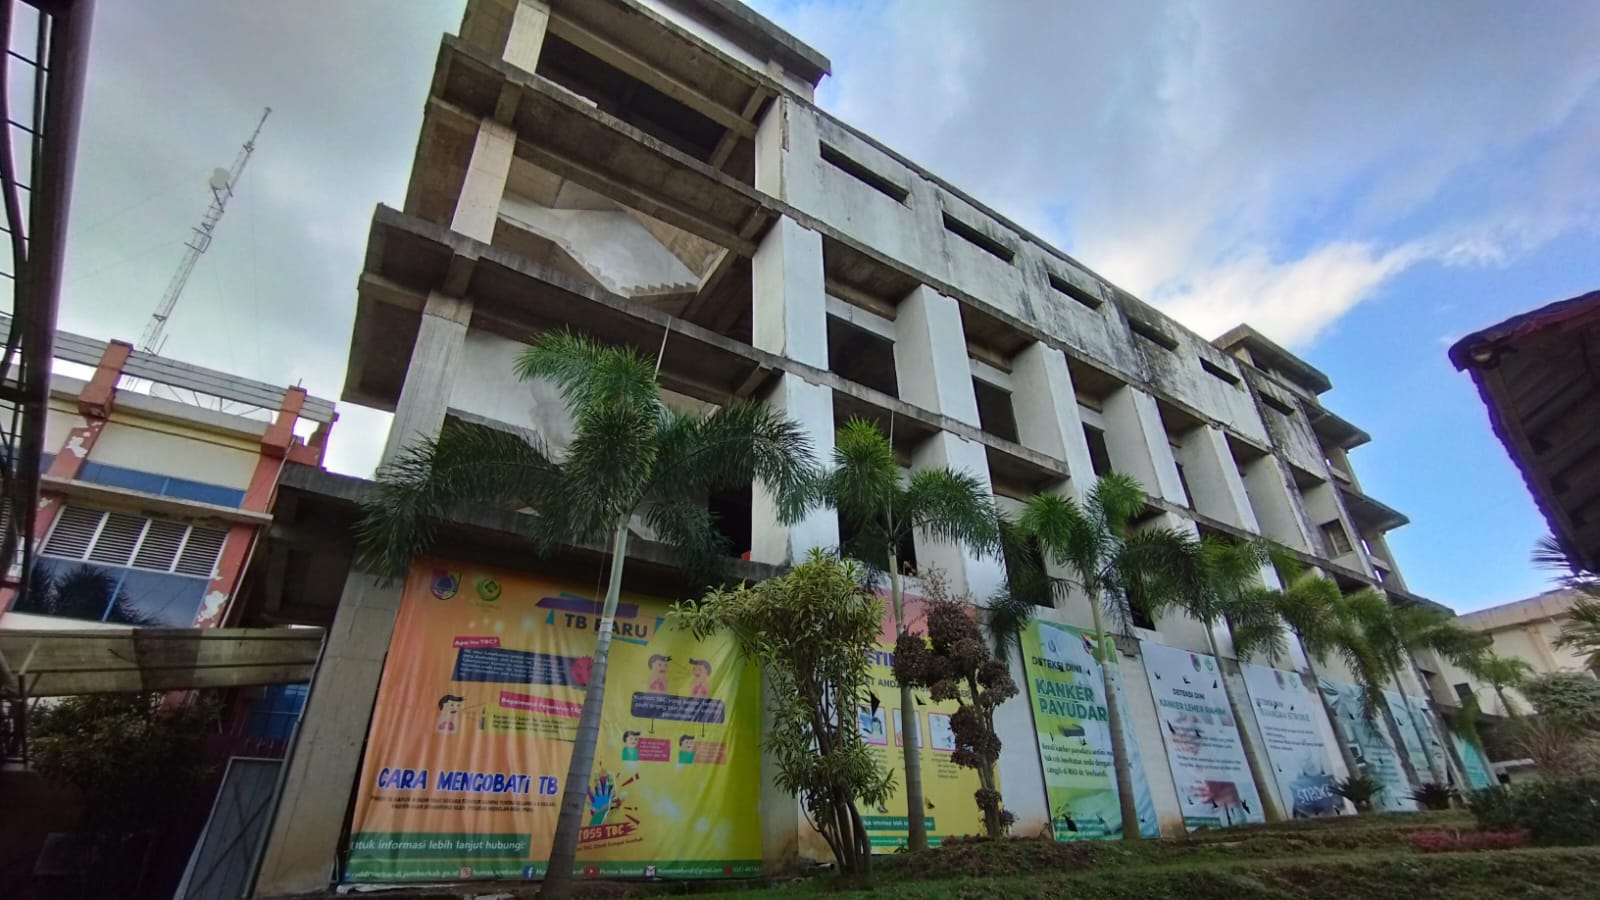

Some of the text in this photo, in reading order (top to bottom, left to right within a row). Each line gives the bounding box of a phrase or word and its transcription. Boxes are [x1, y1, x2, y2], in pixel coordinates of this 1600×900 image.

[564, 613, 588, 630] TB
[1035, 678, 1095, 702] KANKER
[1039, 698, 1109, 721] PAYUDAR
[378, 767, 427, 789] CARA
[538, 776, 558, 795] TB
[605, 824, 625, 837] TBC
[378, 839, 426, 850] informasi
[429, 840, 453, 850] lebih
[456, 840, 483, 853] lanjut
